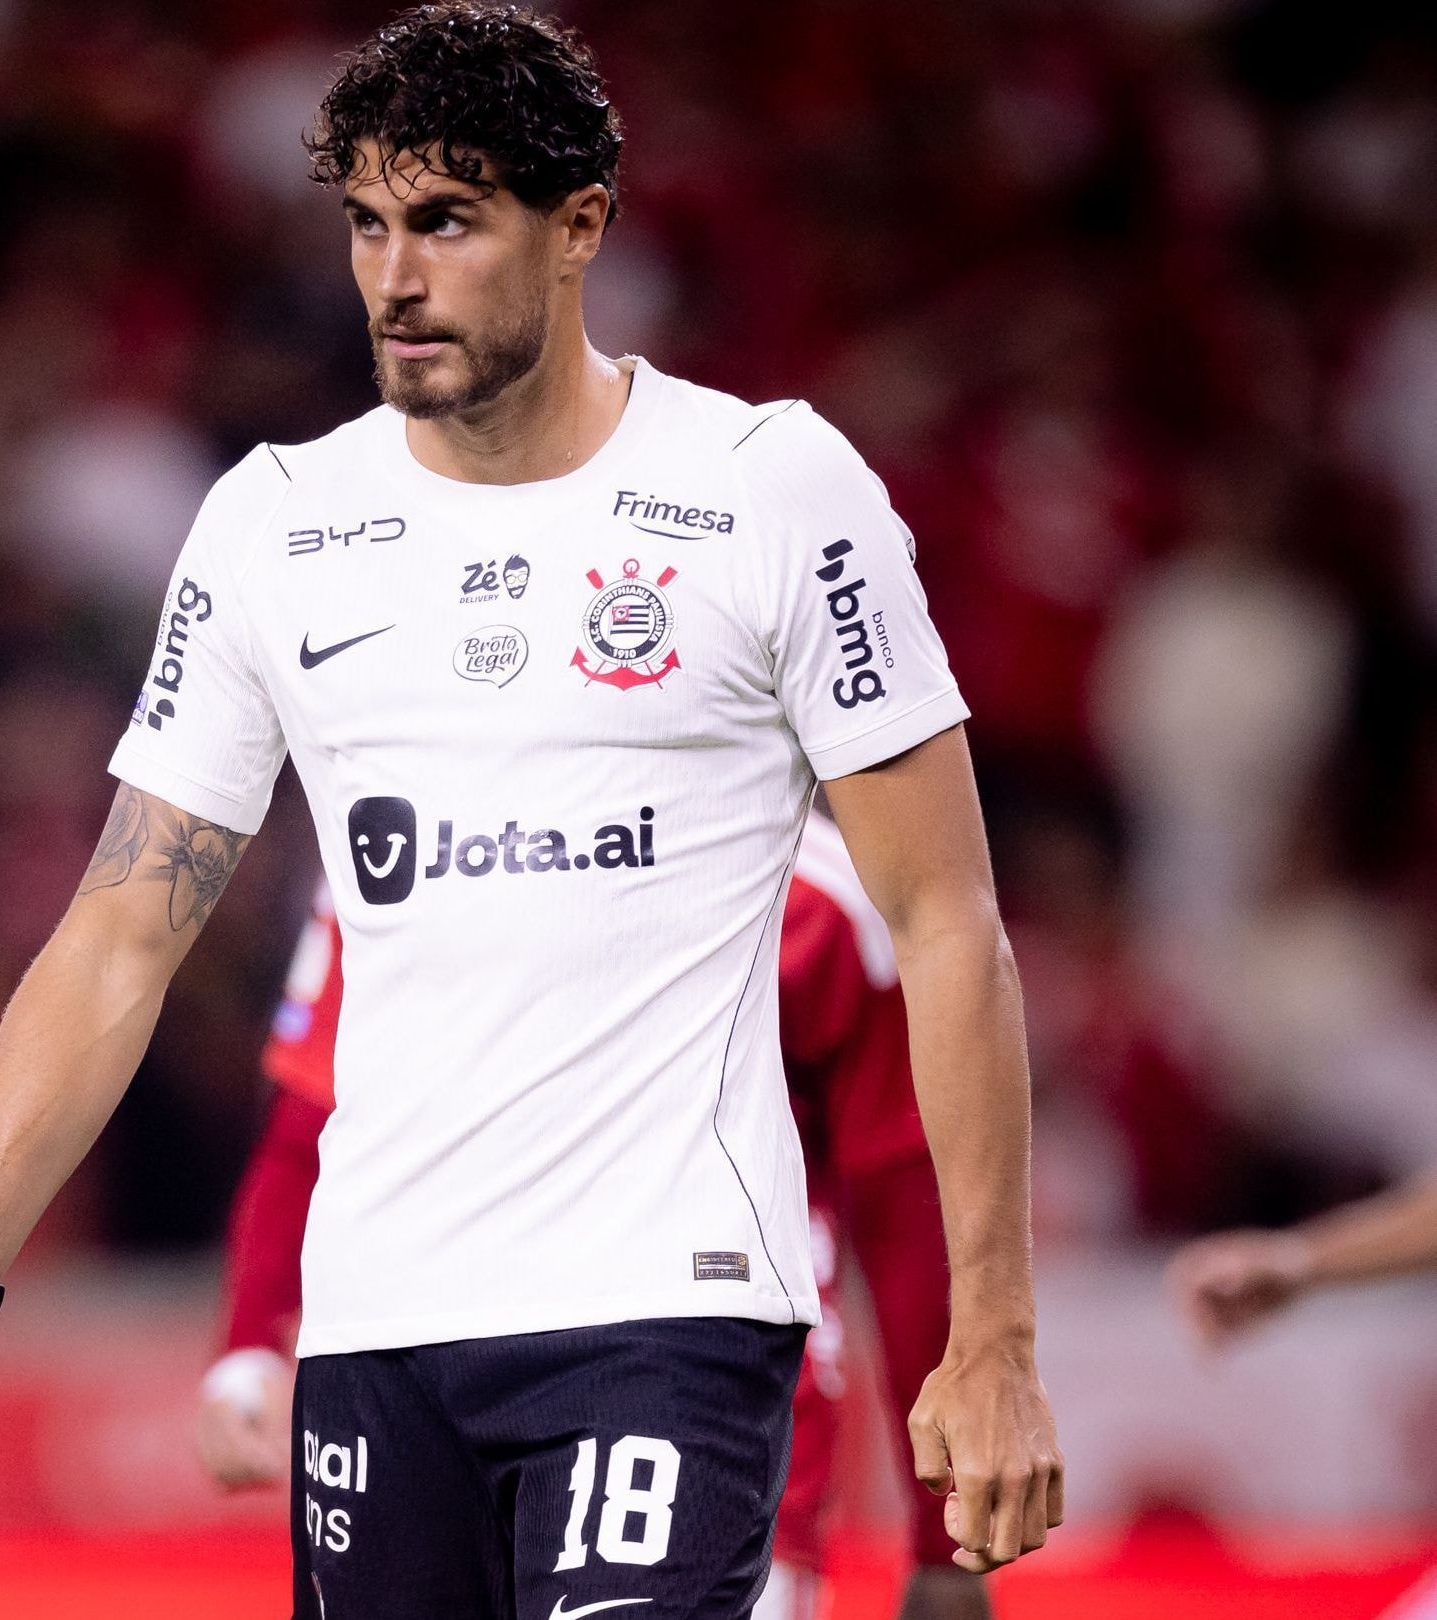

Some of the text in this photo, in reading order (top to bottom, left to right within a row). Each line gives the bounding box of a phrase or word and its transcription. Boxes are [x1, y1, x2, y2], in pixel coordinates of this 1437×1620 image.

[613, 491, 735, 534] Frimesa
[288, 517, 406, 556] BYD
[461, 559, 500, 595] Zé
[459, 594, 499, 604] DELIVERY
[591, 585, 651, 623] CORINTHIANS
[647, 596, 664, 642] PAULISTA
[153, 577, 212, 693] bmg
[464, 635, 517, 655] Broto
[613, 648, 637, 659] 1910
[826, 578, 887, 710] bmg
[872, 610, 895, 669] banco
[466, 648, 519, 673] Legal
[425, 806, 655, 879] Jota.ai
[553, 1435, 681, 1572] 18
